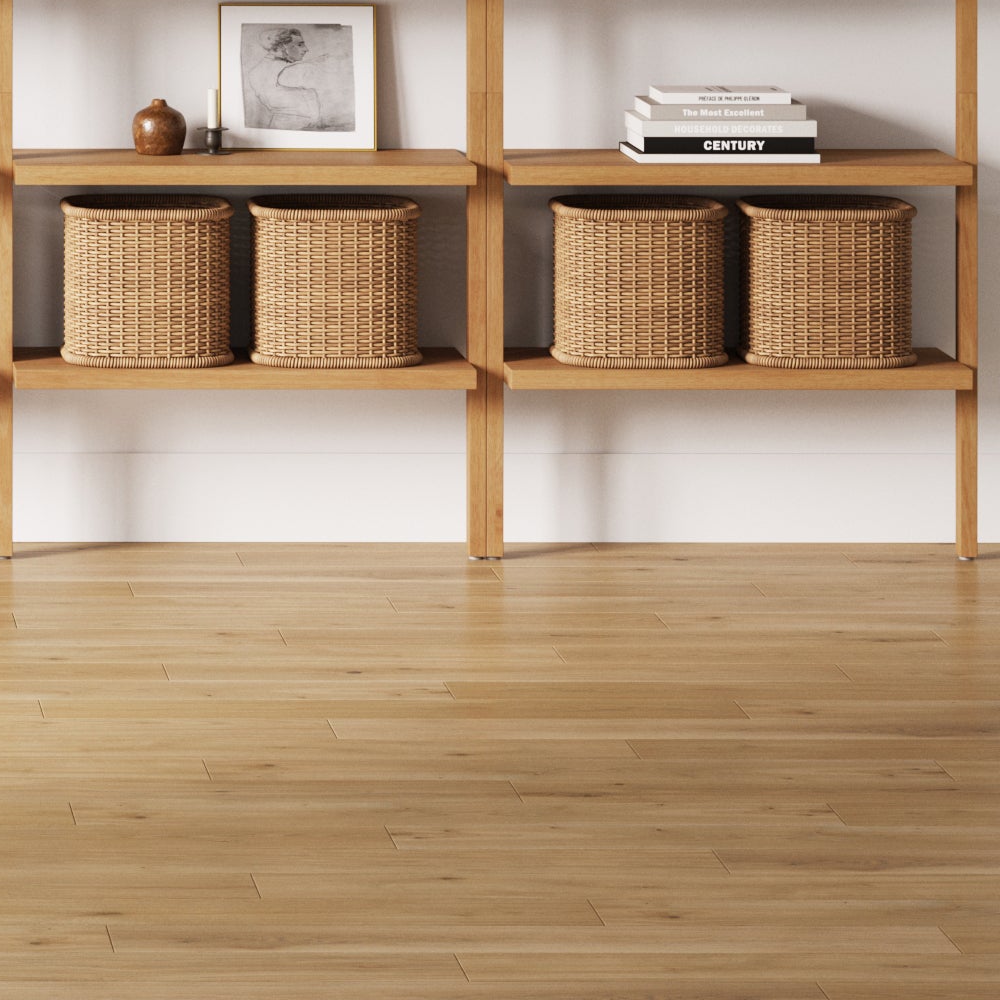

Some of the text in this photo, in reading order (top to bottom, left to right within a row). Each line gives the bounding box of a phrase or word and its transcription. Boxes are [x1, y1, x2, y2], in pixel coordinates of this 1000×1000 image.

[682, 108, 764, 117] The Most Excellent
[674, 125, 783, 134] HOUSEHOLD DECORATES
[703, 140, 766, 151] CENTURY
